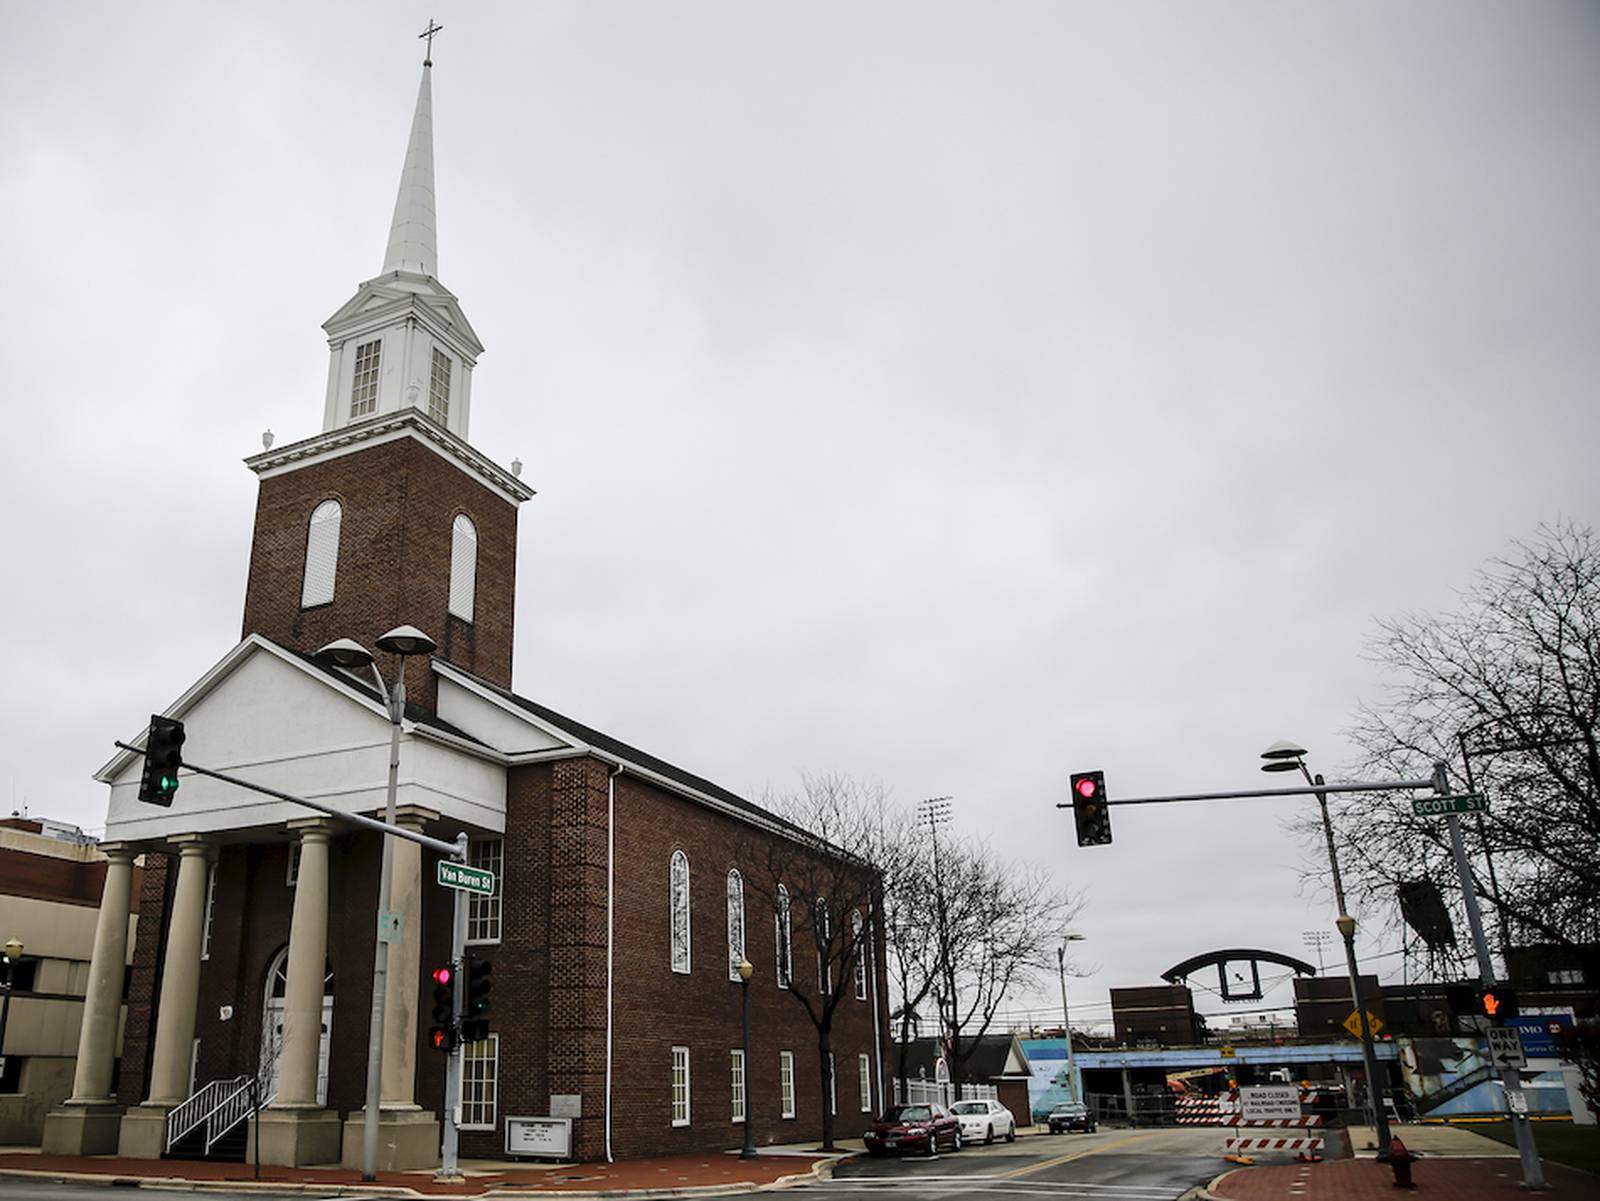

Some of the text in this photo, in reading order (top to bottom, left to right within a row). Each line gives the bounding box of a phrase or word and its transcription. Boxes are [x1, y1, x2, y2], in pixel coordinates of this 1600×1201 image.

[1415, 797, 1482, 814] SCOTT ST
[441, 867, 490, 890] Van Buren St
[1490, 1029, 1517, 1040] ONE
[1491, 1041, 1518, 1051] WAY
